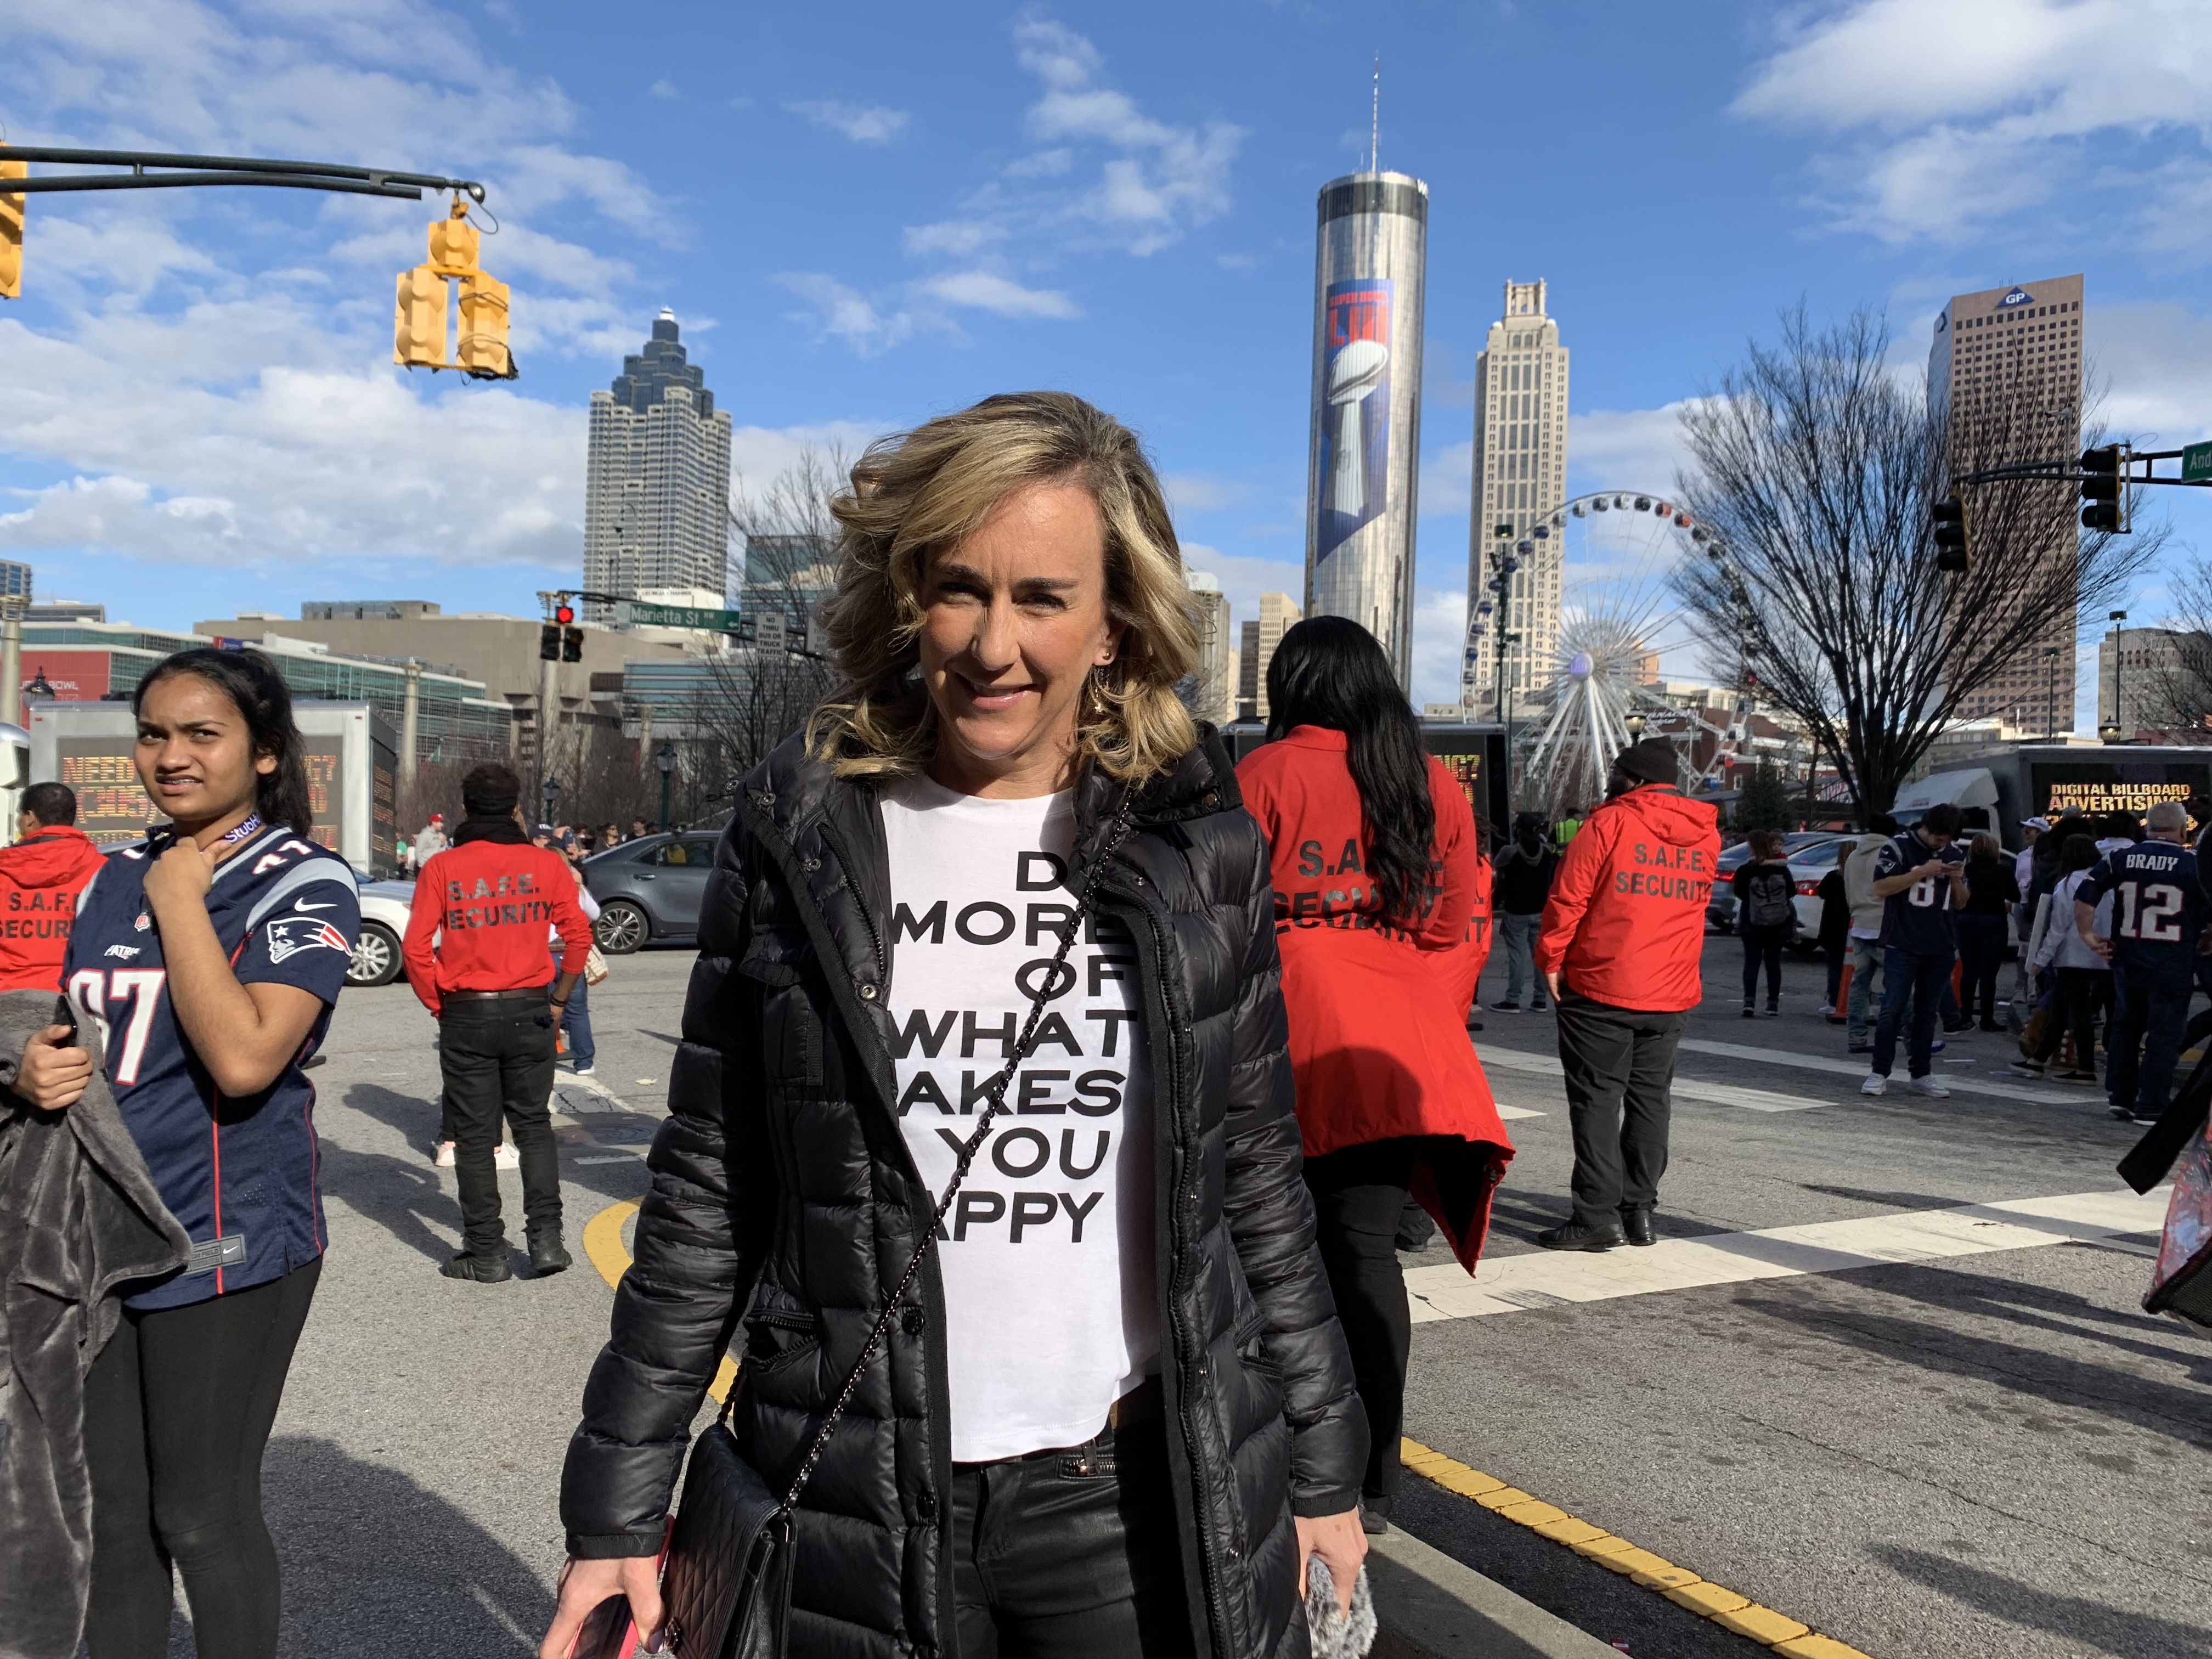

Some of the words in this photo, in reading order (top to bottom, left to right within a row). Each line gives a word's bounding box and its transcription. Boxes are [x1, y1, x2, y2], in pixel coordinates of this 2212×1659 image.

[2006, 292, 2025, 303] GP
[1329, 305, 1388, 348] LIII
[2190, 449, 2212, 471] And
[631, 607, 681, 624] Marietta
[686, 611, 700, 625] St
[703, 611, 714, 619] NW
[48, 681, 78, 690] BOWL
[63, 757, 134, 782] NEED
[2051, 784, 2108, 795] DIGITAL
[2112, 784, 2191, 795] BILLBOARD
[1016, 851, 1069, 892] D
[1634, 843, 1705, 872] S.A.F.E.
[2126, 854, 2179, 871] BRADY
[448, 873, 540, 901] S.A.F.E.
[1615, 871, 1712, 902] SECURITY
[449, 900, 554, 930] ECURITY
[893, 900, 1135, 947] MORE
[2118, 881, 2184, 943] 12
[0, 919, 73, 939] ECUR
[1015, 955, 1136, 1002] OF
[888, 1008, 1138, 1059] WHAT
[898, 1070, 1126, 1117] AKES
[935, 1127, 1111, 1180] YOU
[925, 1190, 1104, 1244] APPY
